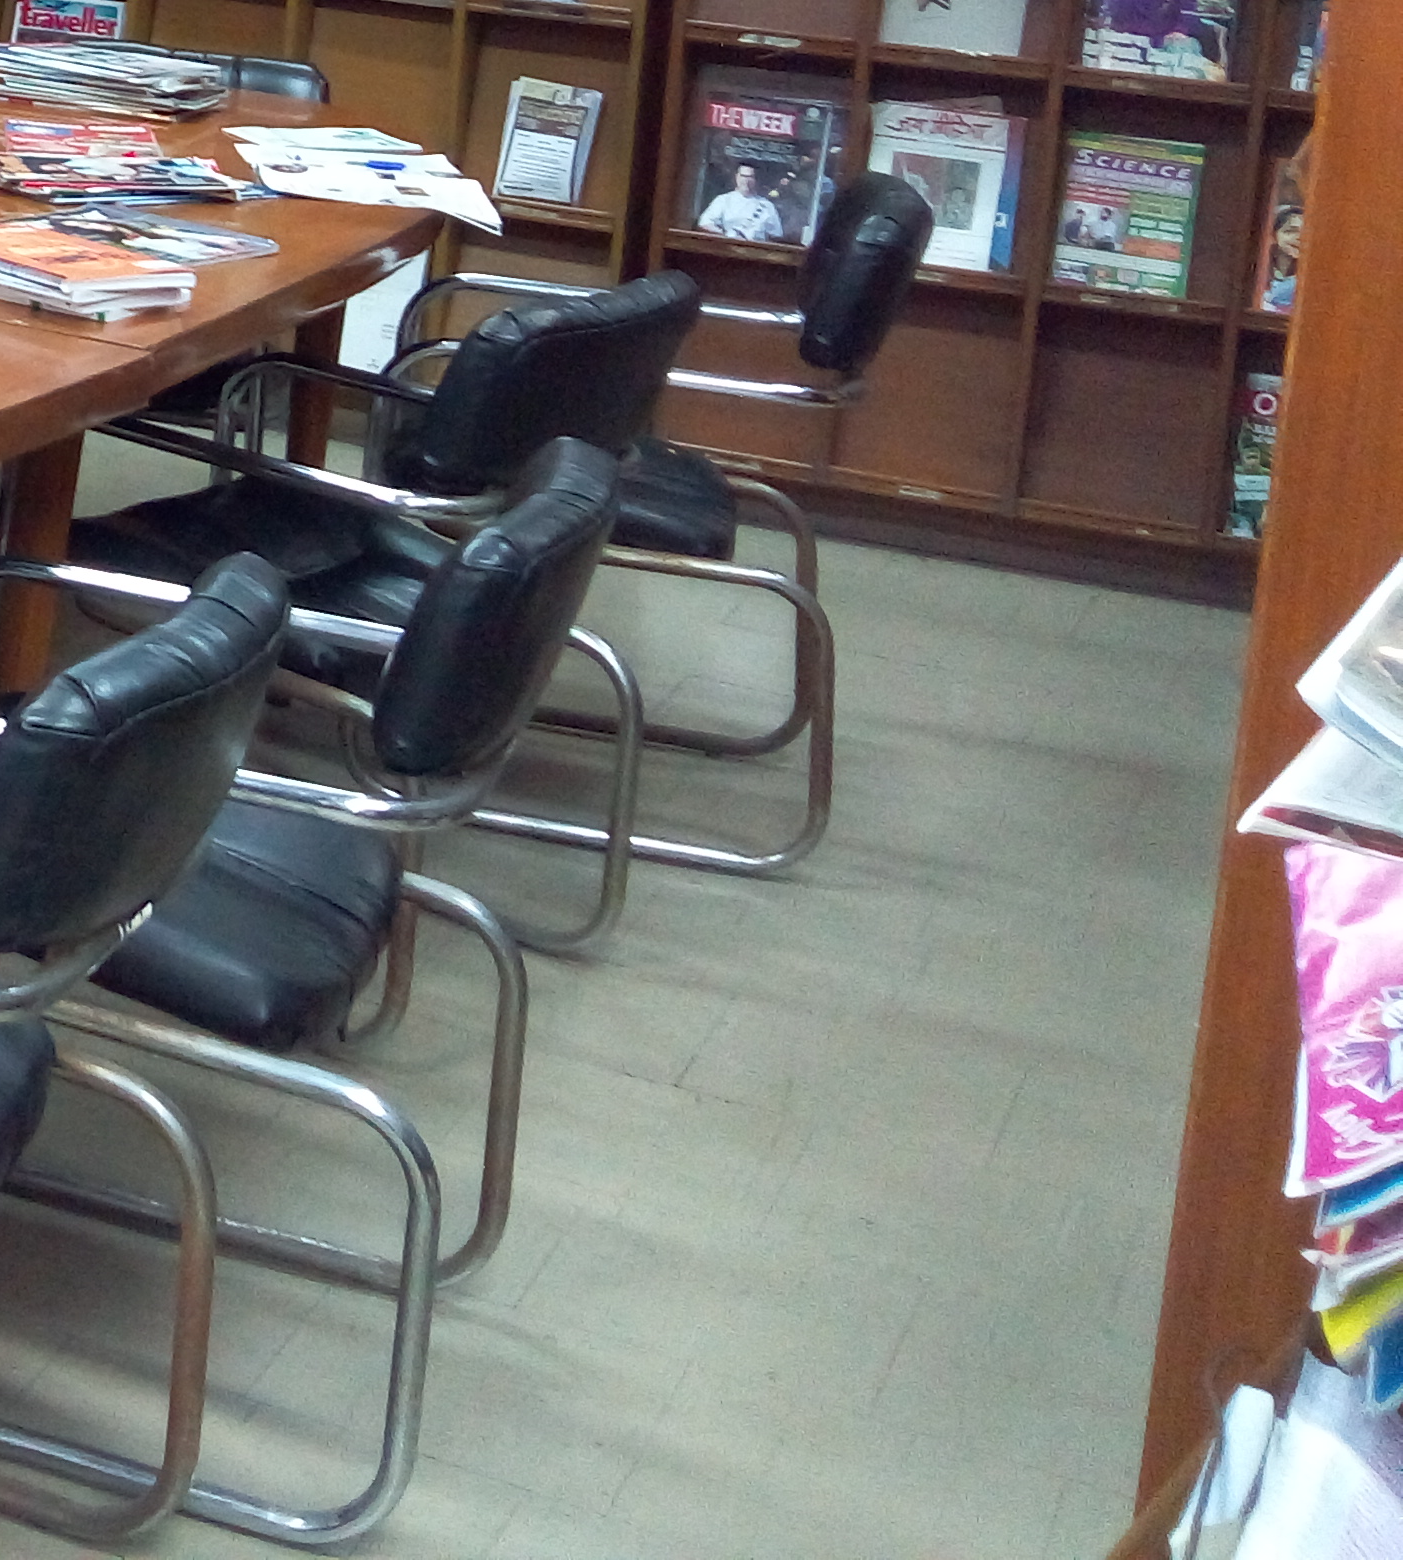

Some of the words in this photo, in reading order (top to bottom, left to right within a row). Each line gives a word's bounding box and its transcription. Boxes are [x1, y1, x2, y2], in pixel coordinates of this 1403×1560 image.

[19, 1, 118, 37] traveller
[709, 103, 743, 130] THE
[742, 109, 797, 137] WEEK
[1075, 148, 1192, 181] SCIENCE
